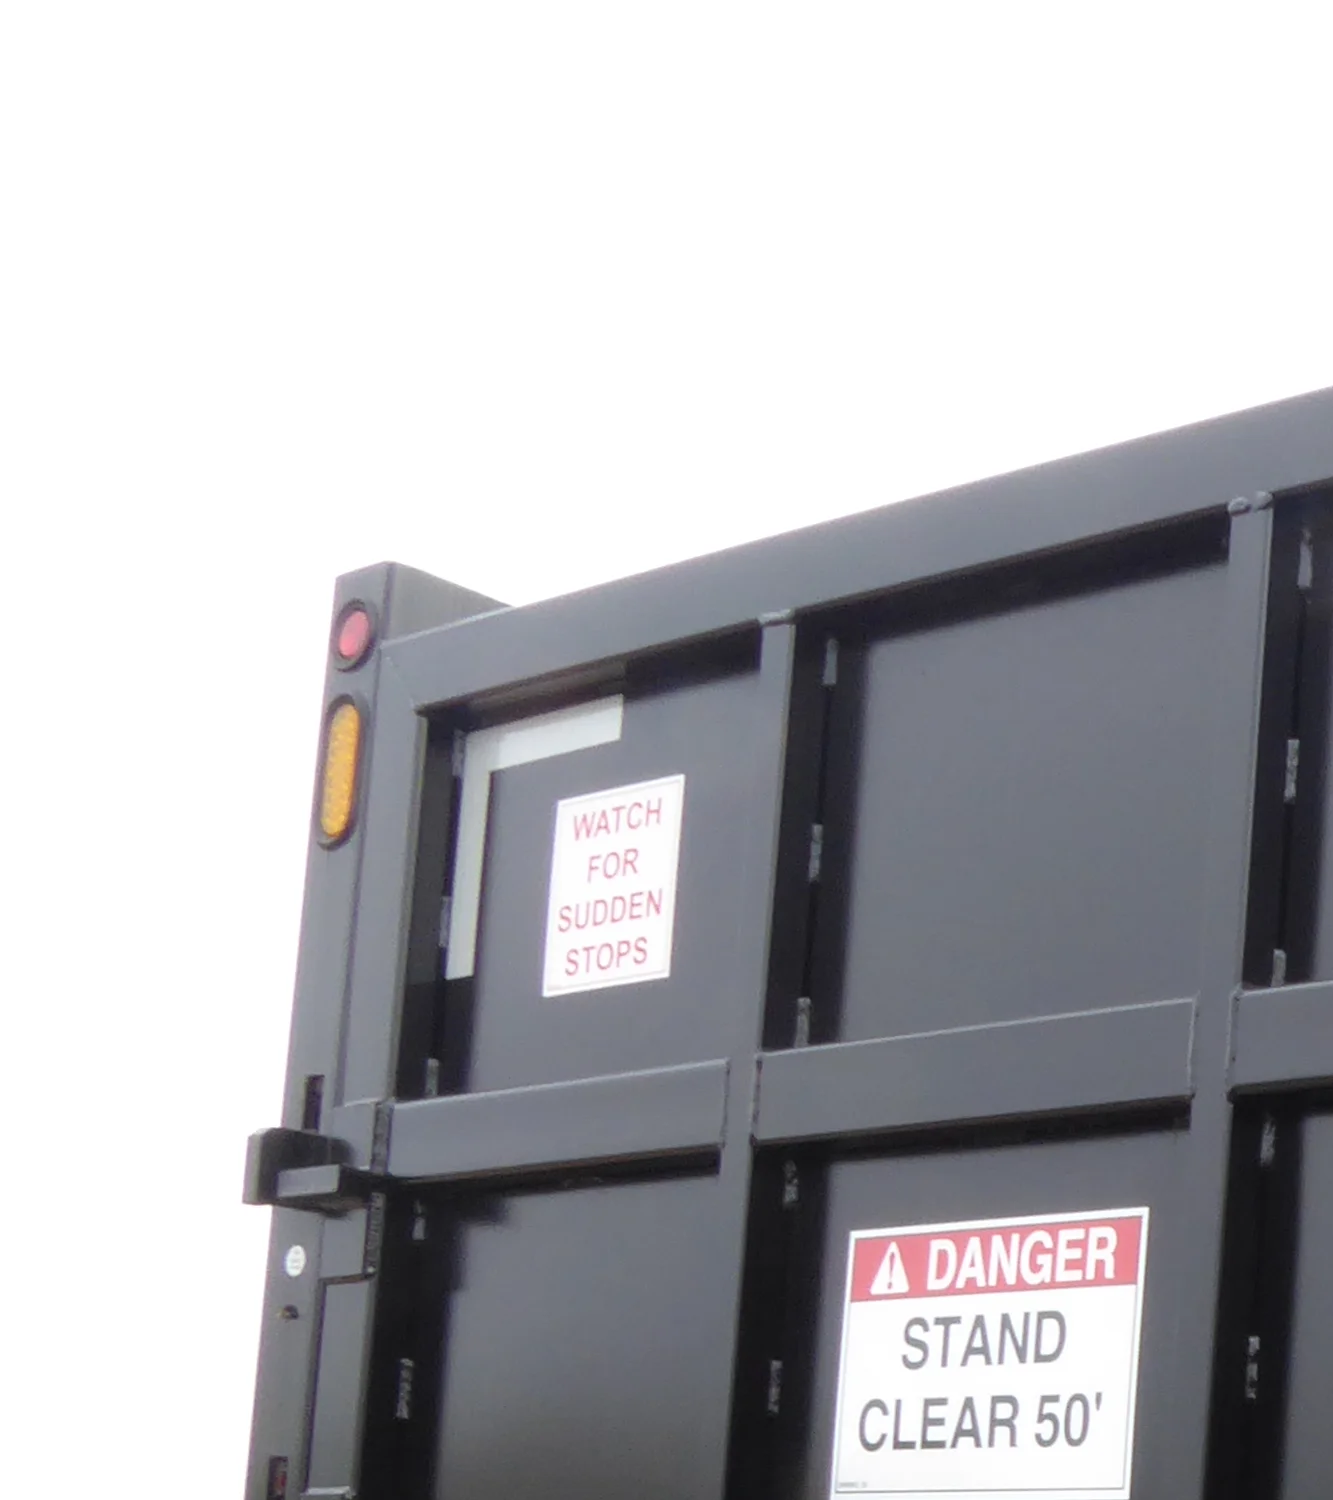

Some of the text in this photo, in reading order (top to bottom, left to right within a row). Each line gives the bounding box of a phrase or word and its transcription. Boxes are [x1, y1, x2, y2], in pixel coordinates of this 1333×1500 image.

[573, 798, 662, 841] WATCH
[587, 848, 639, 883] FOR
[557, 889, 663, 933] SUDDEN
[565, 937, 648, 977] STOPS
[926, 1226, 1118, 1291] DANGER
[901, 1310, 1067, 1370] STAND
[858, 1392, 1103, 1452] CLEAR 50'
